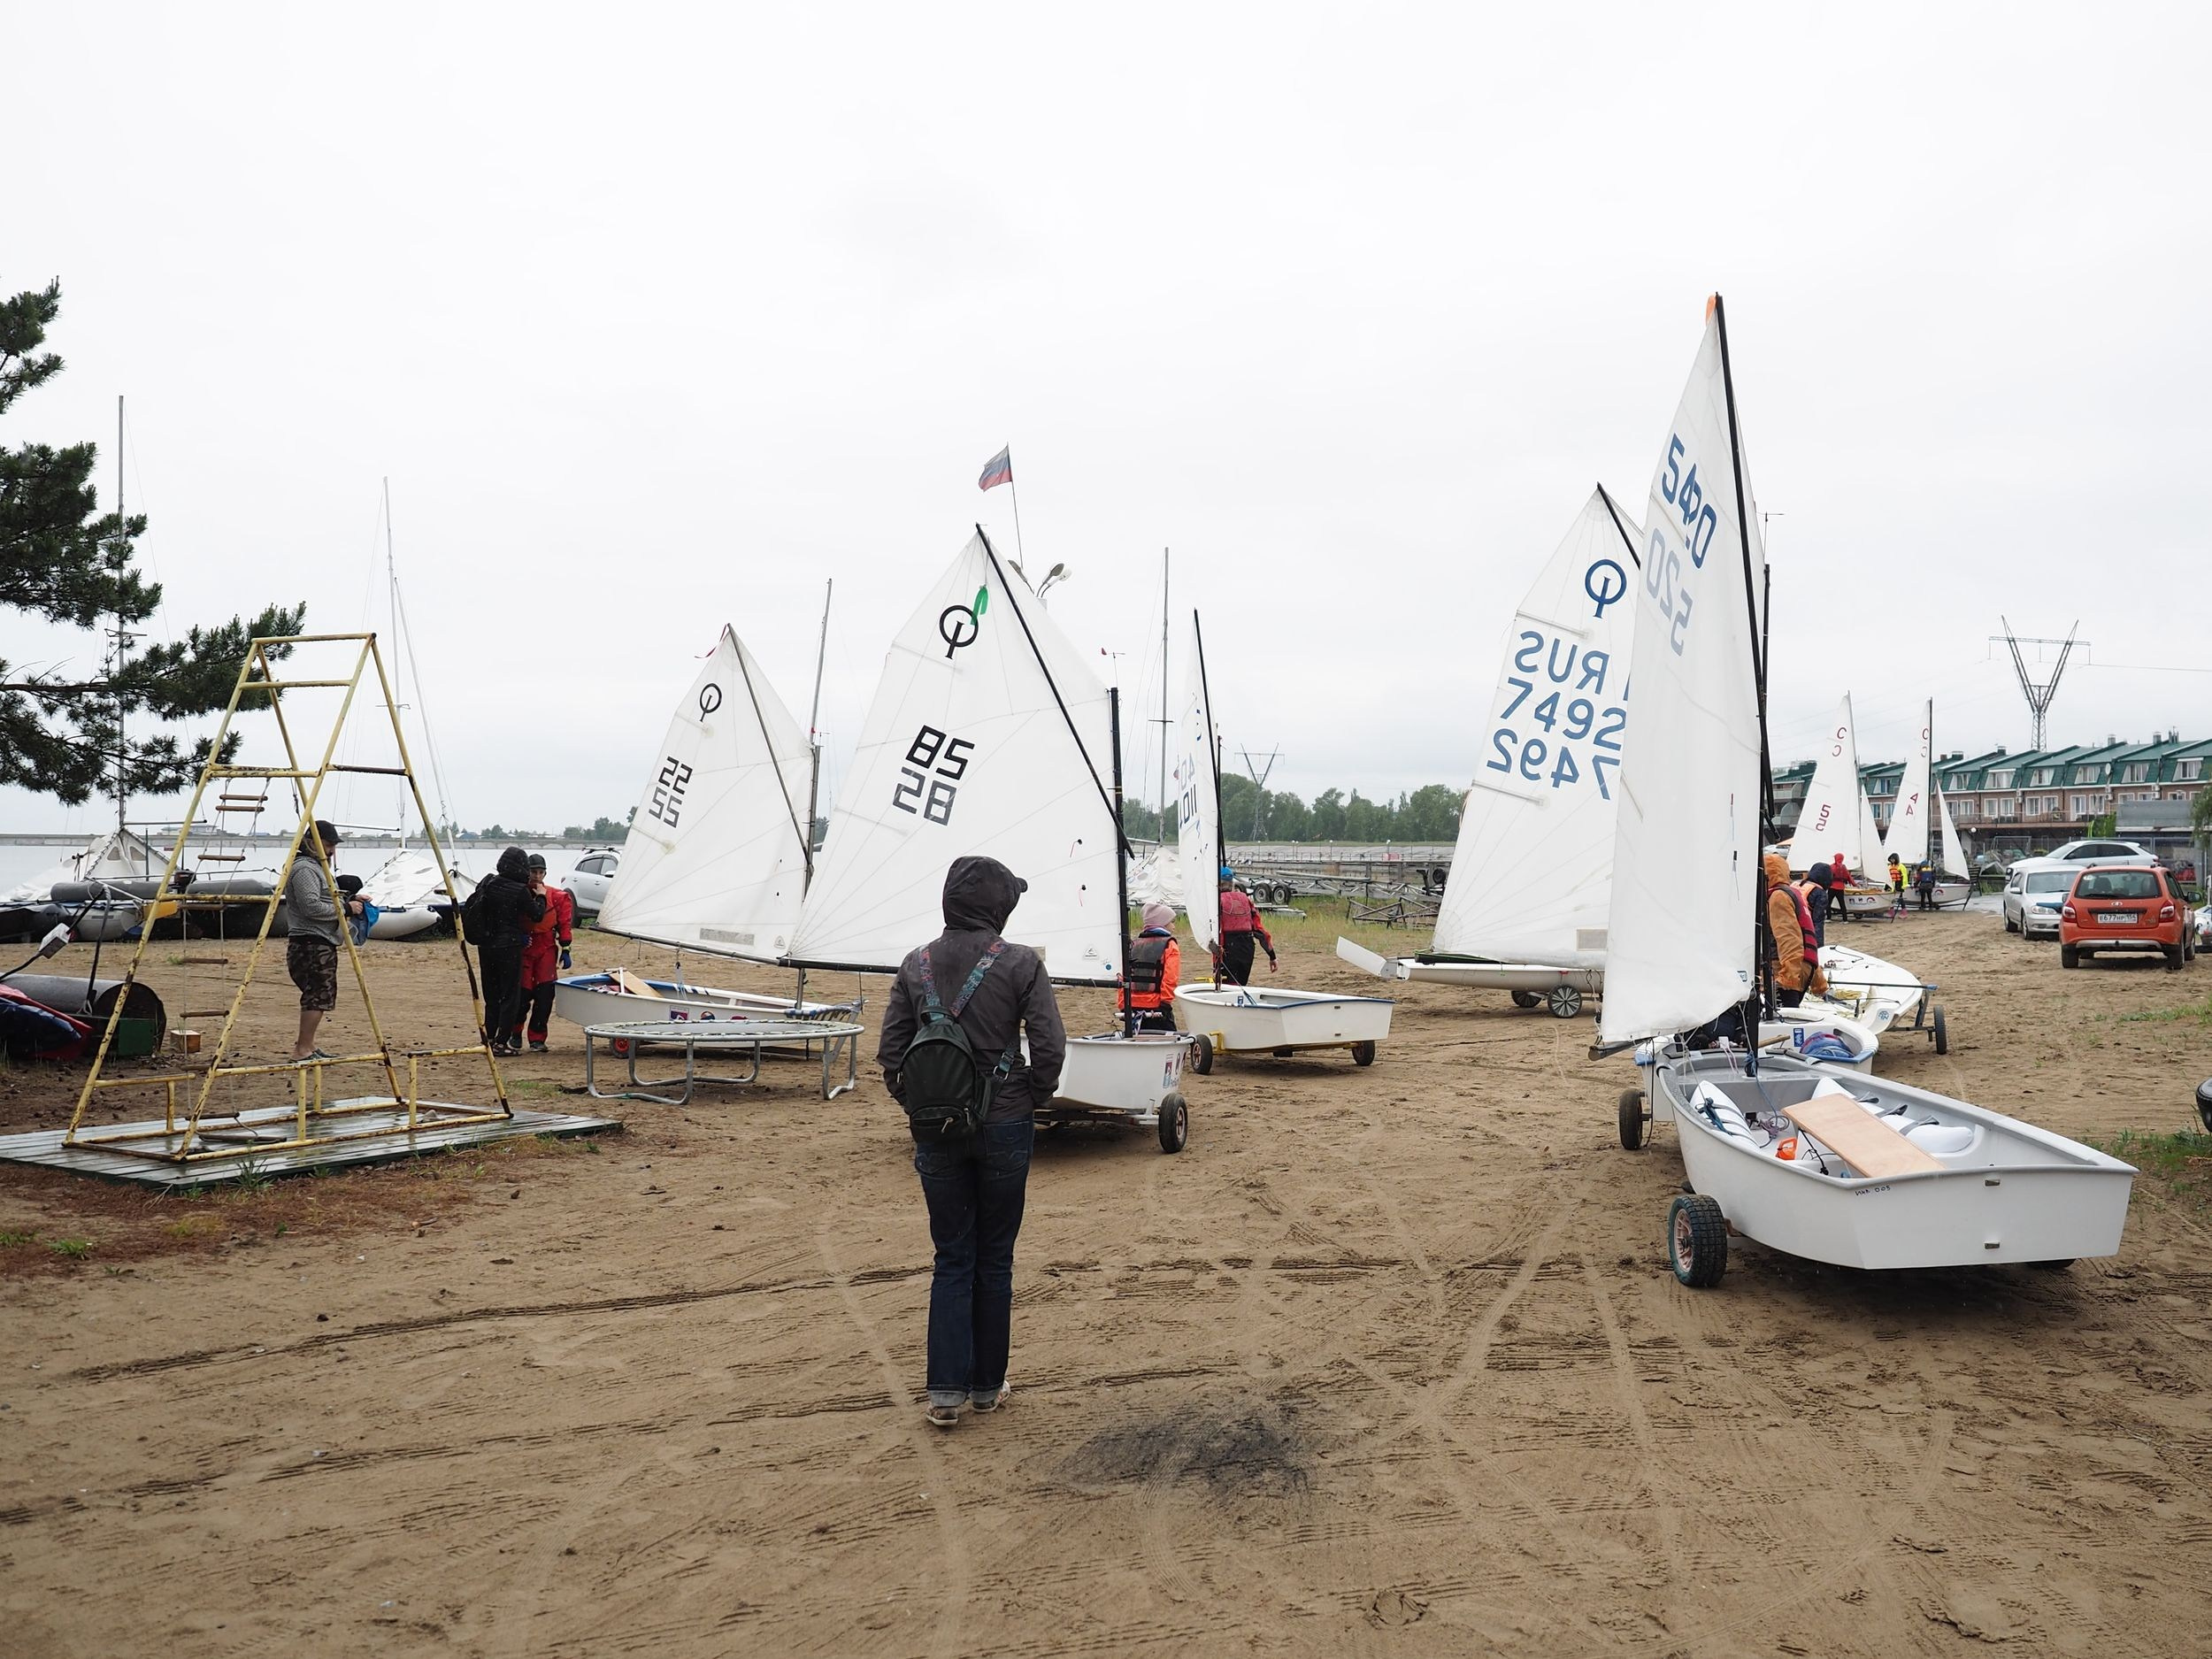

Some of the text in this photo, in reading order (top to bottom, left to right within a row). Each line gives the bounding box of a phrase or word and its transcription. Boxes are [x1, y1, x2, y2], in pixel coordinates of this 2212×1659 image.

[1500, 676, 1627, 752] 7492
[658, 756, 693, 795] 22
[905, 725, 975, 780] 85
